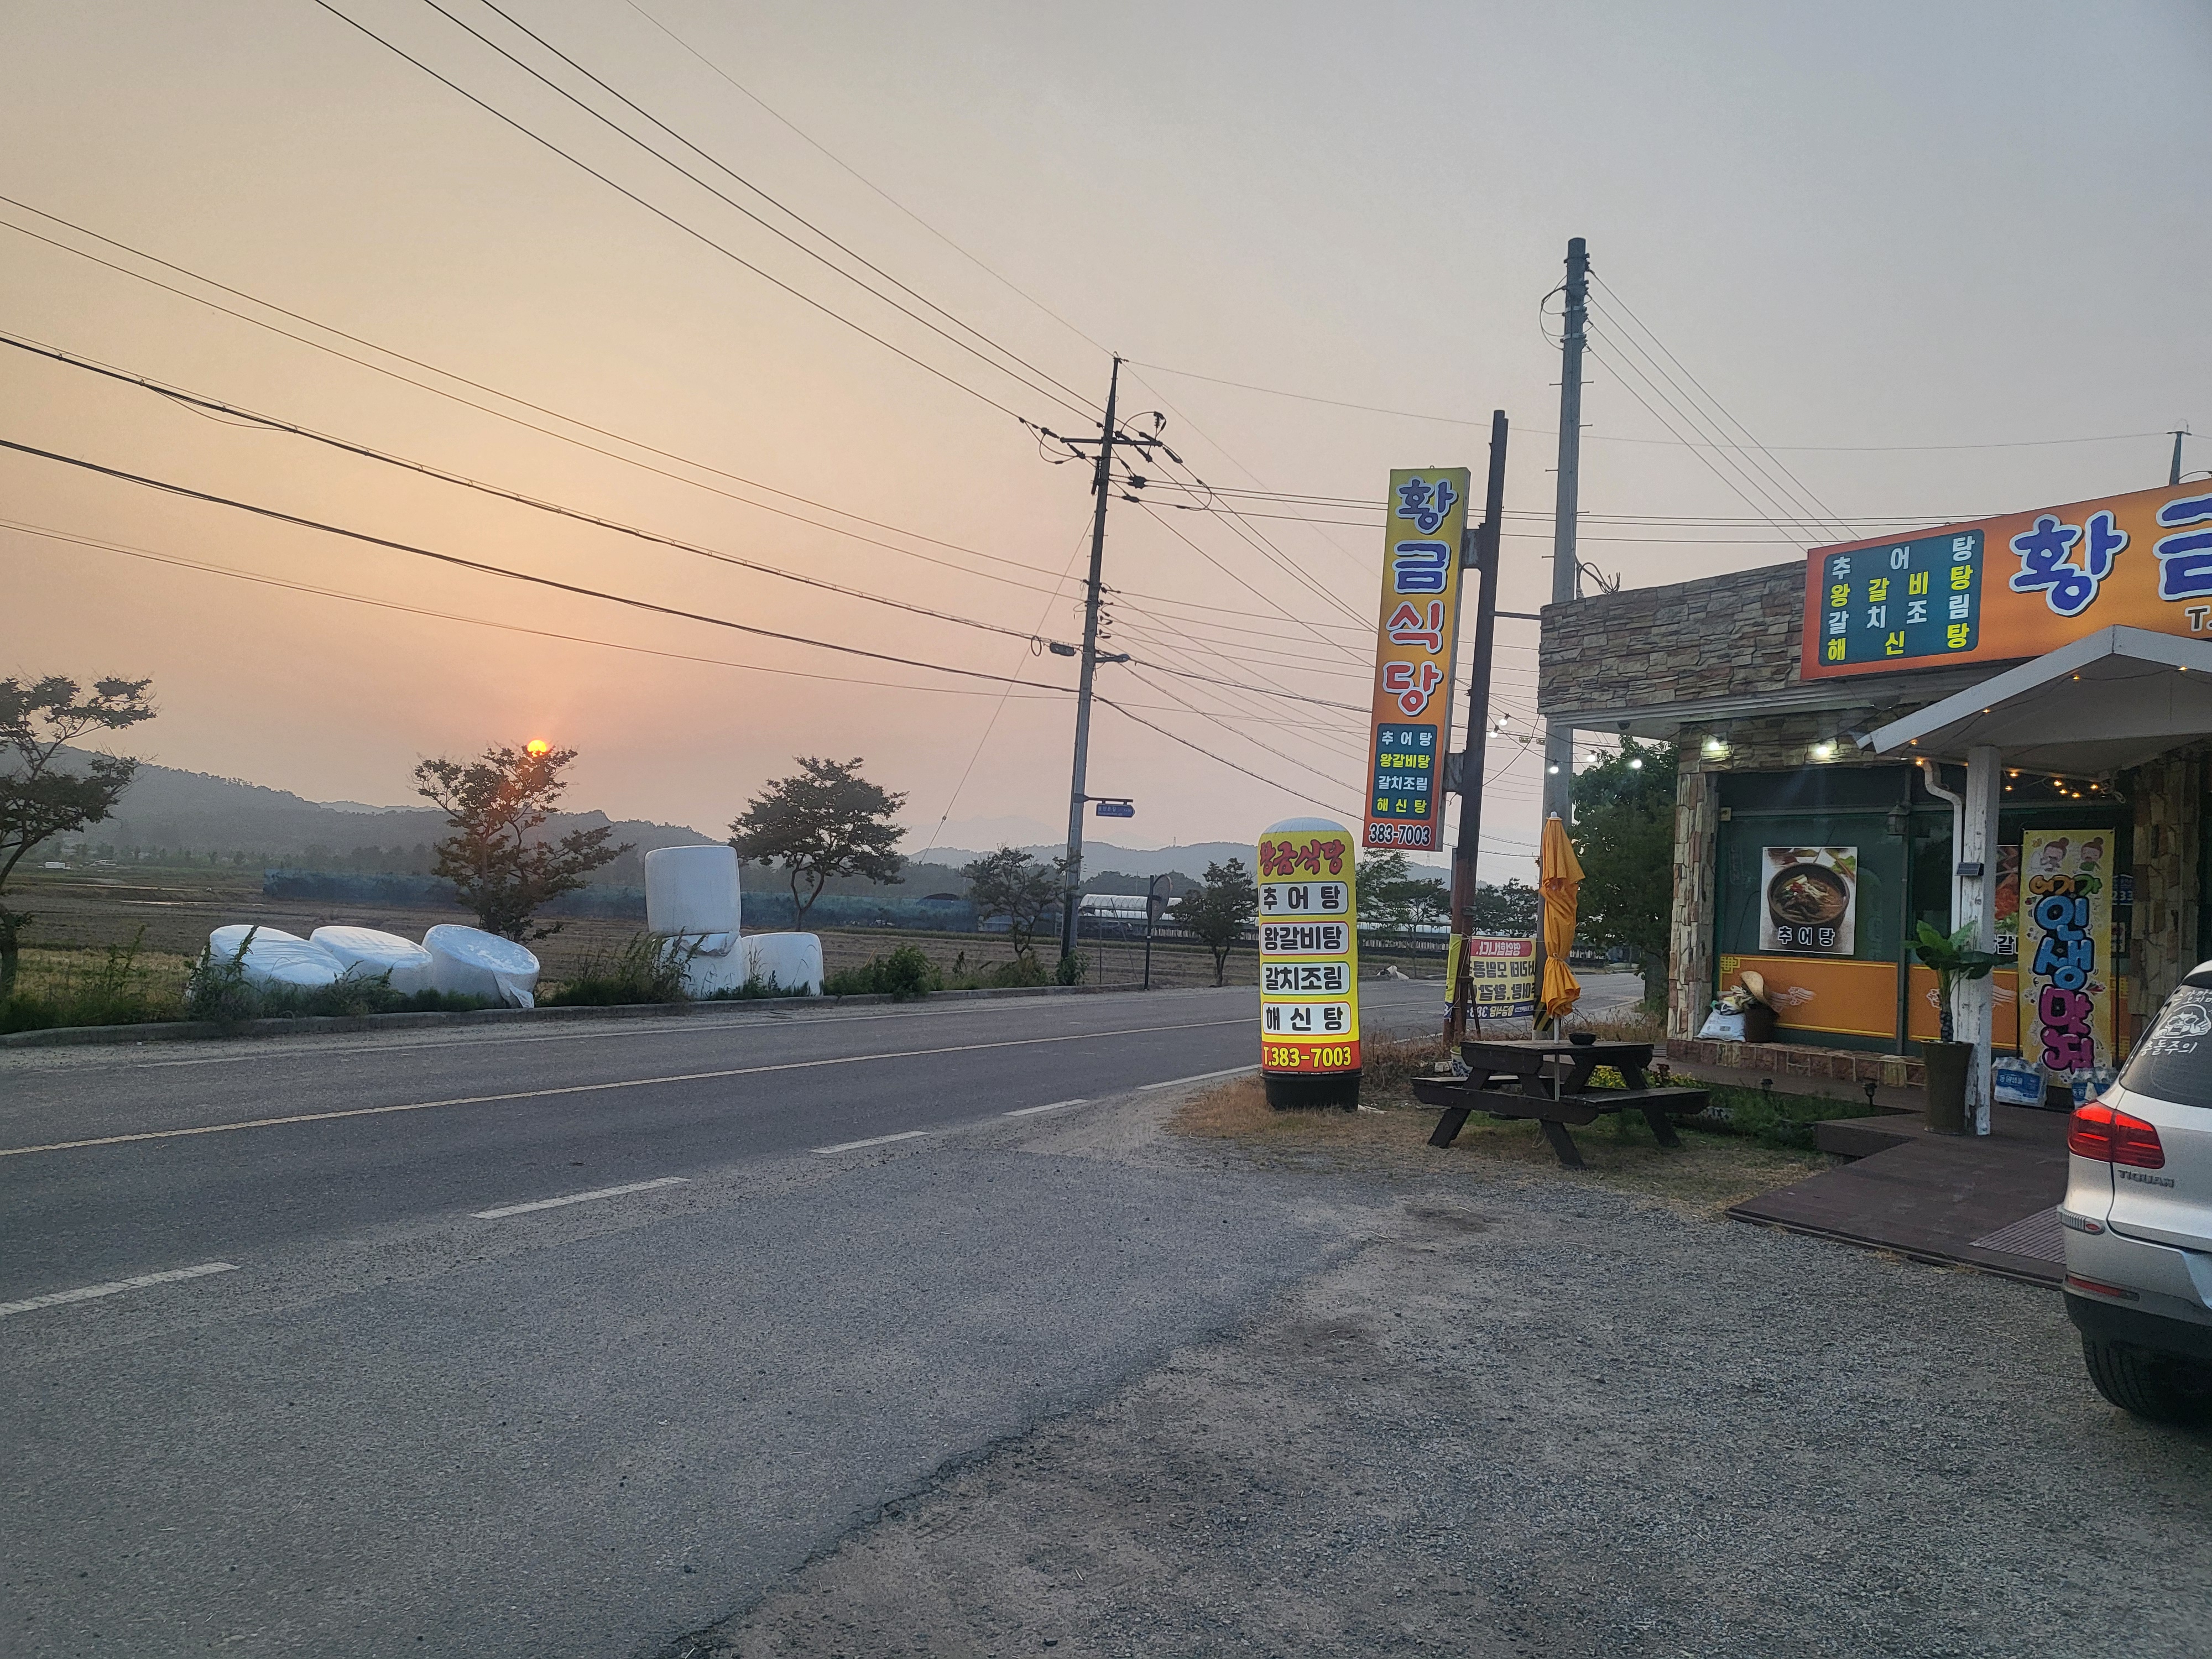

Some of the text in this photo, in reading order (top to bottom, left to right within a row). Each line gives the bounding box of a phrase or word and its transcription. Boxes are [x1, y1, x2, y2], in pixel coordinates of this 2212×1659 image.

[1383, 474, 1457, 716] 황금식당
[1379, 753, 1431, 770] 왕갈비탕
[1378, 775, 1428, 791] 갈치조림
[1368, 823, 1431, 846] 383-7003
[1259, 839, 1345, 876] 황금식당
[1264, 926, 1342, 951] 왕갈비탕
[1778, 926, 1835, 947] 추어탕
[1265, 967, 1342, 991] 갈치조림
[1263, 1046, 1352, 1068] T.383-7003
[2141, 1039, 2198, 1056] 충돌주의
[2117, 1169, 2175, 1188] TIGUAN
